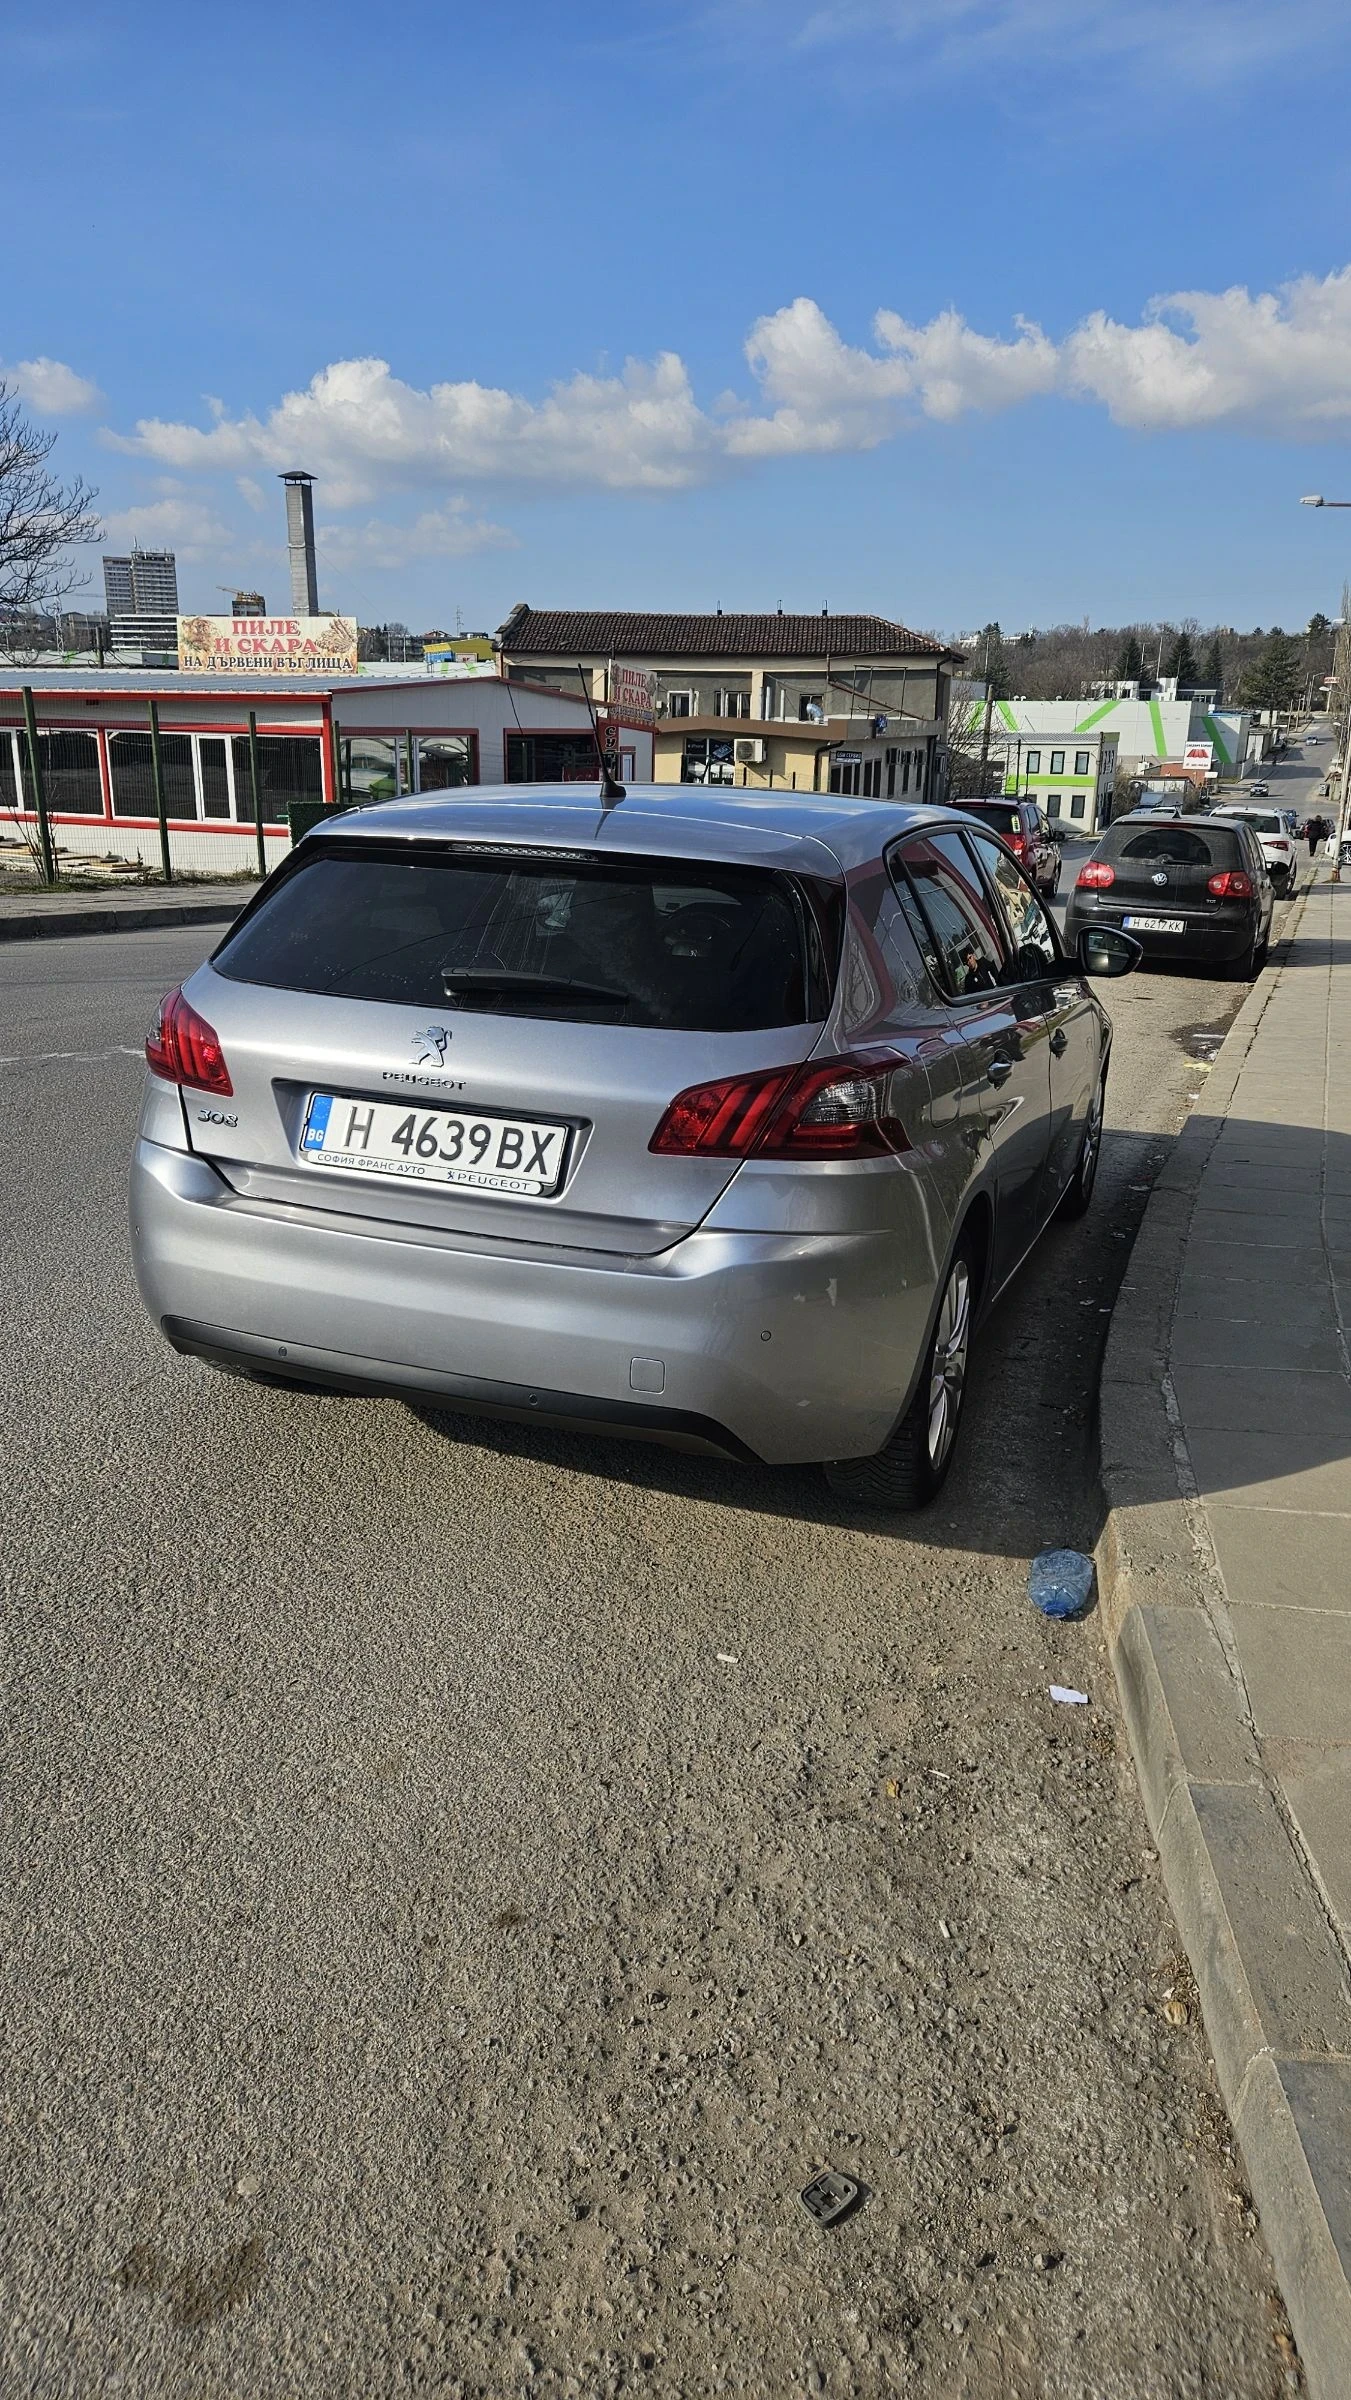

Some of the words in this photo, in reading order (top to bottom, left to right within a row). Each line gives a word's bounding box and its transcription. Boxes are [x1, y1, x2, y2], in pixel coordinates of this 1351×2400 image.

[232, 620, 301, 636] ПИЛЕ
[214, 638, 230, 653] И
[237, 638, 320, 654] СКАРА
[184, 657, 203, 668] НА
[207, 657, 273, 670] ДЪРВЕНИ
[276, 657, 353, 670] ВЪГЛИЩА
[622, 668, 647, 691] ПИЛЕ
[623, 687, 652, 709] СКАРА
[382, 1071, 467, 1090] PEUGEOT
[197, 1109, 239, 1127] 308
[307, 1128, 324, 1142] BG
[317, 1153, 355, 1165] СОФИЯ
[358, 1159, 395, 1171] ФРАНС
[397, 1164, 425, 1175] АУТО
[457, 1173, 531, 1190] PEUGEOT
